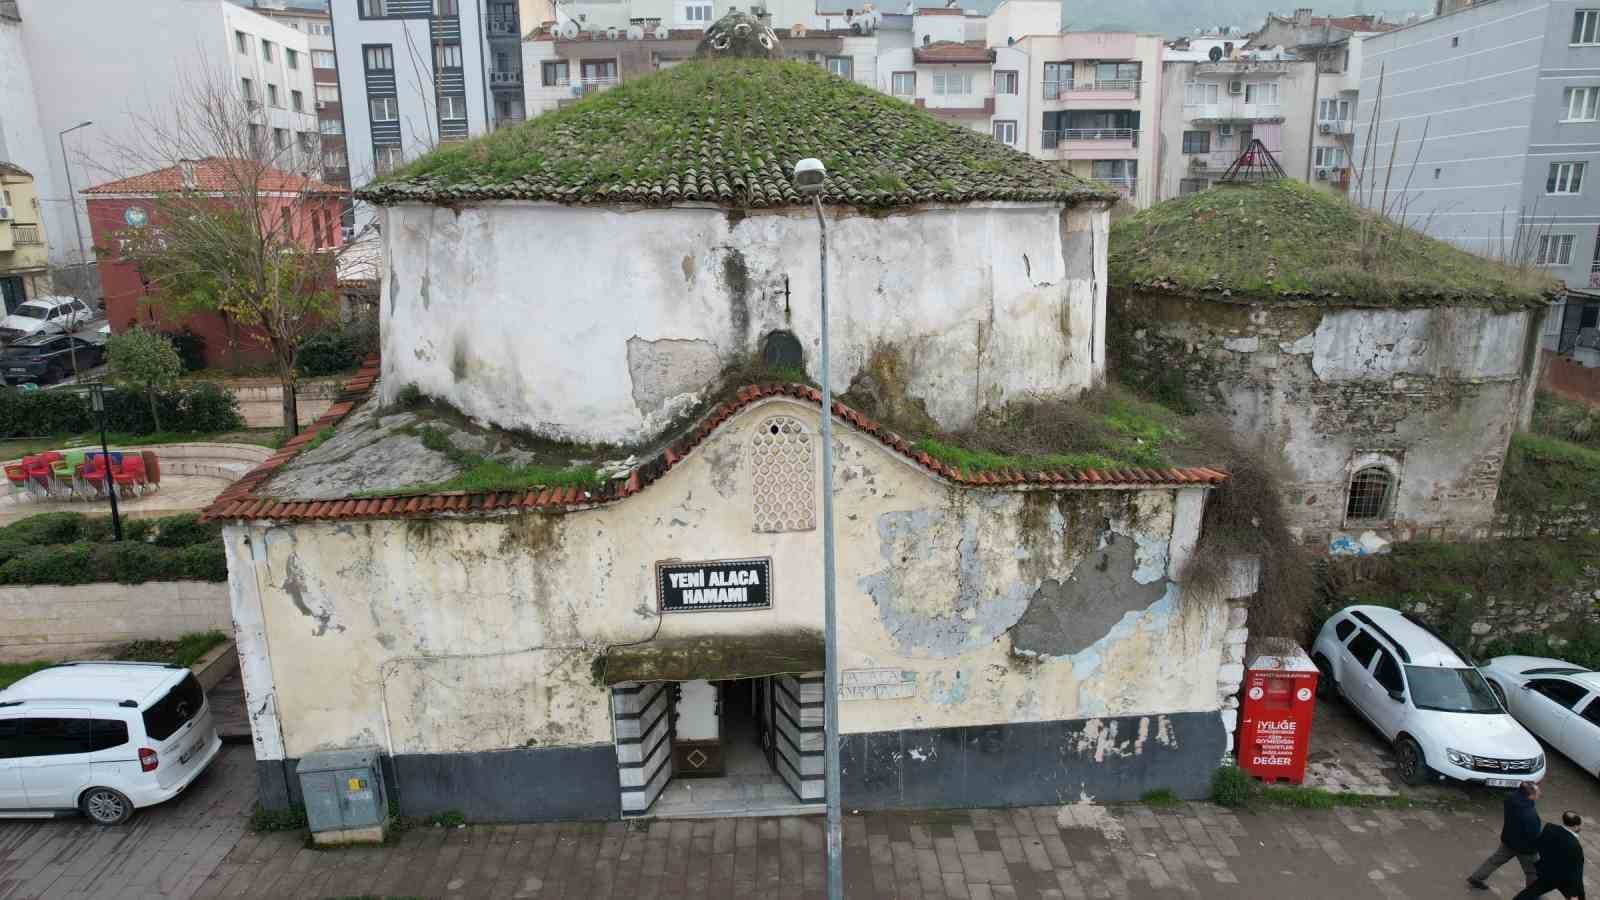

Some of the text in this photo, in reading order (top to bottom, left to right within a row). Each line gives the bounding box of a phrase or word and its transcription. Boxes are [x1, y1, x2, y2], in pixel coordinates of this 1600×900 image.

[669, 569, 760, 588] YENİ ALACA
[683, 587, 748, 604] HAMAMI
[1253, 755, 1292, 766] DEĞER
